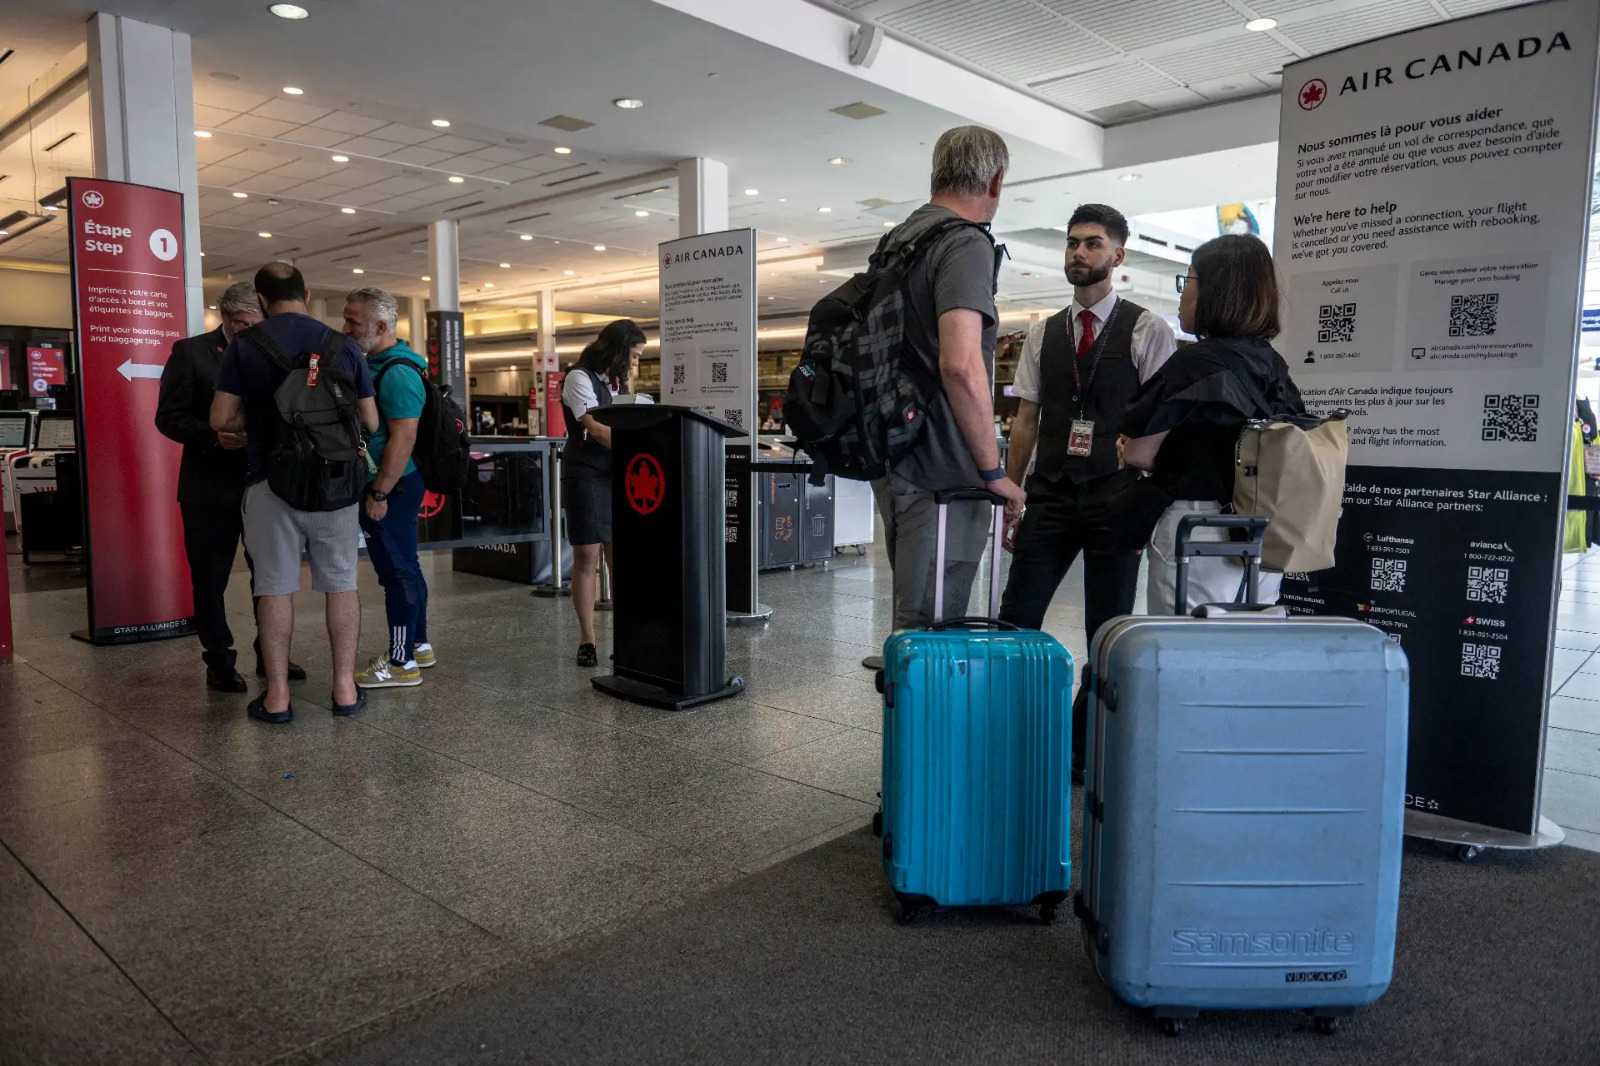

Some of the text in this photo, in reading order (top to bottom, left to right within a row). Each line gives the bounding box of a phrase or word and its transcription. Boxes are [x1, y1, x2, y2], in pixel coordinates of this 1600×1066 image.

[1339, 31, 1572, 96] AIR CANADA
[1298, 107, 1503, 154] Nous sommes là pour vous aider
[1297, 118, 1554, 168] Si vous avez manqué un vol de correspondance, que
[1296, 128, 1560, 178] votre vol a été annulé ou que vous avez besoin d'aide
[1295, 142, 1563, 191] pour modifier votre réservation, vous pouvez compter
[1295, 188, 1331, 200] sur nous.
[1293, 227, 1328, 238] Whether
[1330, 222, 1358, 235] you've
[1361, 216, 1393, 228] missed
[1404, 210, 1464, 223] connection,
[1467, 207, 1493, 218] your
[1497, 202, 1527, 214] flight
[1294, 201, 1397, 226] We're here to help
[84, 219, 132, 238] Étape
[1292, 214, 1540, 249] is cancelled or you need assistance with rebooking,
[85, 239, 123, 256] Step
[160, 238, 168, 252] 1
[1291, 240, 1388, 259] we've got you covered.
[674, 245, 743, 263] AIR CANADA
[88, 286, 127, 295] Imprimez
[150, 291, 167, 299] carte
[88, 296, 120, 304] d'accès
[128, 298, 146, 306] bord
[89, 306, 132, 314] étiquettes
[144, 309, 174, 318] bagages.
[132, 327, 164, 337] boarding
[108, 336, 143, 345] baggage
[144, 338, 162, 346] tags.
[1300, 386, 1453, 397] lication d'Air Canada indique toujours
[1305, 399, 1353, 407] seignements
[1354, 398, 1366, 406] les
[1368, 397, 1385, 407] plus
[1387, 397, 1393, 406] à
[1395, 397, 1413, 407] jour
[1432, 397, 1445, 405] les
[1307, 408, 1326, 417] tions
[1353, 426, 1380, 436] always
[1382, 427, 1397, 435] has
[1400, 427, 1414, 435] the
[1417, 428, 1440, 436] most
[1351, 437, 1366, 445] and
[1368, 436, 1390, 447] flight
[1392, 437, 1446, 446] information.
[1369, 484, 1381, 494] de
[1383, 487, 1402, 495] nos
[1404, 488, 1464, 498] partenaires
[1467, 489, 1491, 499] Star
[1493, 490, 1541, 502] Alliance
[1374, 496, 1393, 506] Star
[1395, 498, 1434, 509] Alliance
[1436, 502, 1483, 512] partners:
[1377, 535, 1414, 544] Lufthansa
[1470, 541, 1503, 550] avianca
[1304, 596, 1325, 604] AIRLINES
[114, 621, 179, 634] STAR ALLIANCE
[1475, 617, 1505, 627] SWISS
[1172, 928, 1354, 956] Samsonite
[1287, 971, 1345, 982] YUKAKO
